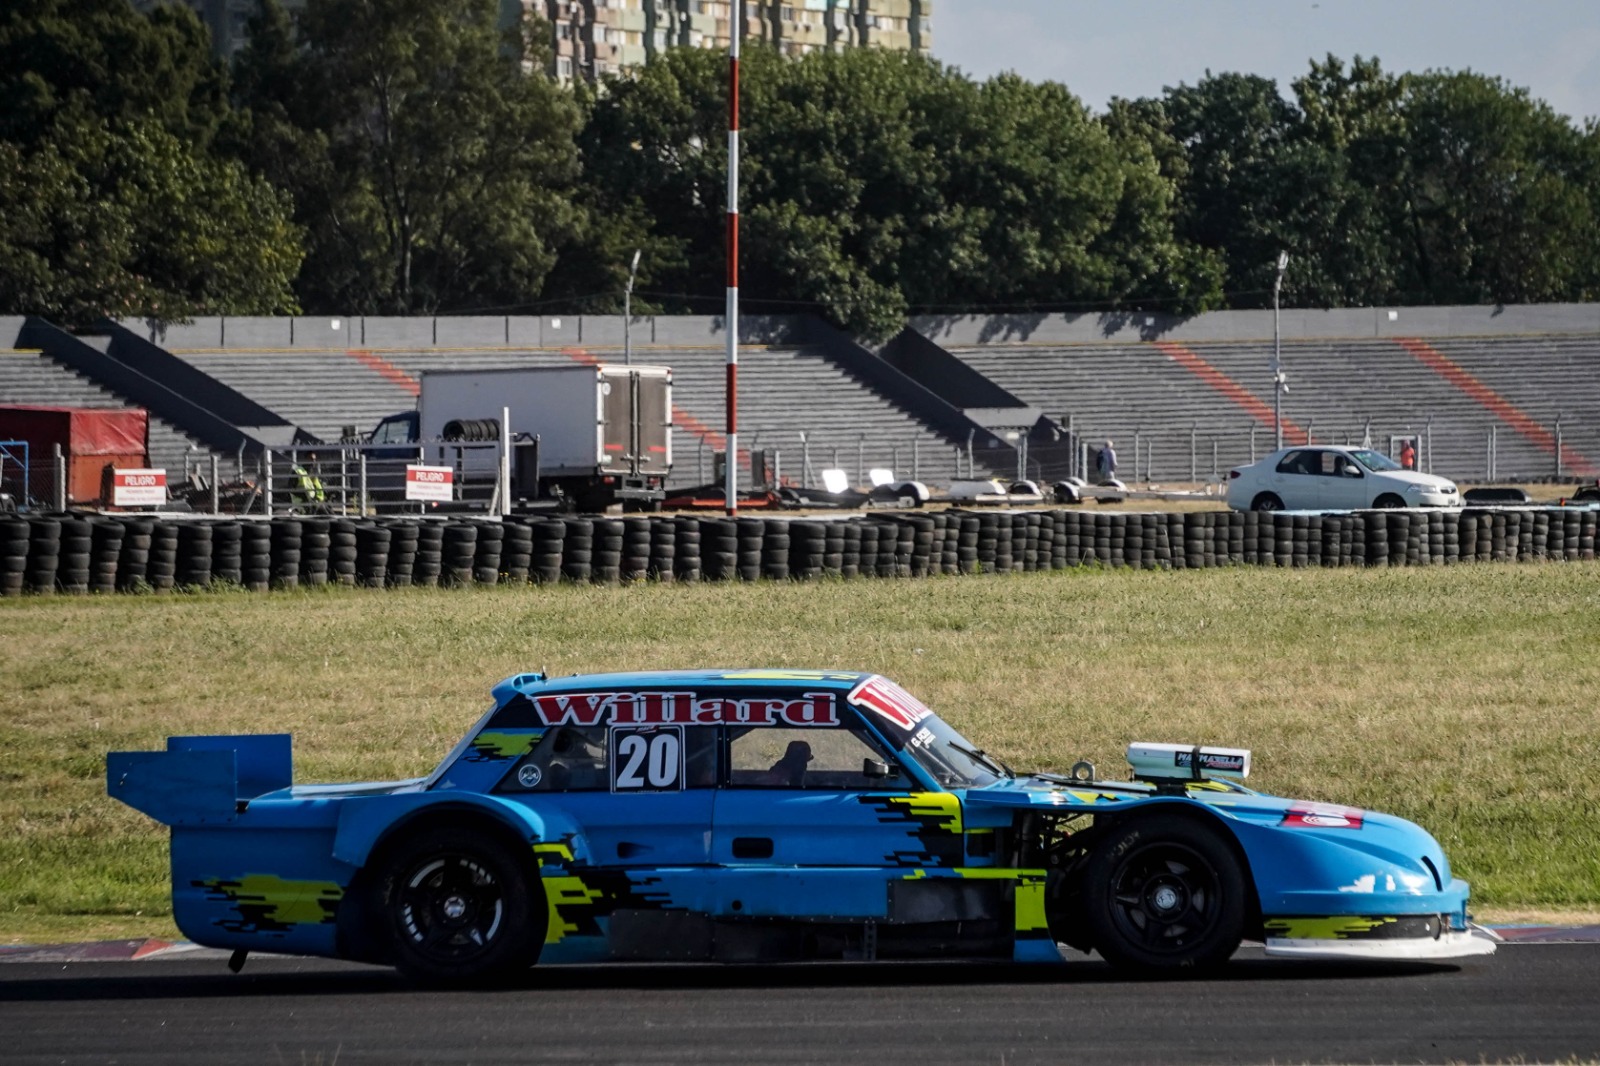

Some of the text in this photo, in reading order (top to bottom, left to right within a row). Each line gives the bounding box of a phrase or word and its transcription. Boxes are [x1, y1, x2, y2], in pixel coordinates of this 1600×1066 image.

[125, 475, 156, 486] PELIGRO
[416, 471, 444, 482] PELIGRO
[527, 691, 840, 727] Willard
[616, 734, 679, 788] 20
